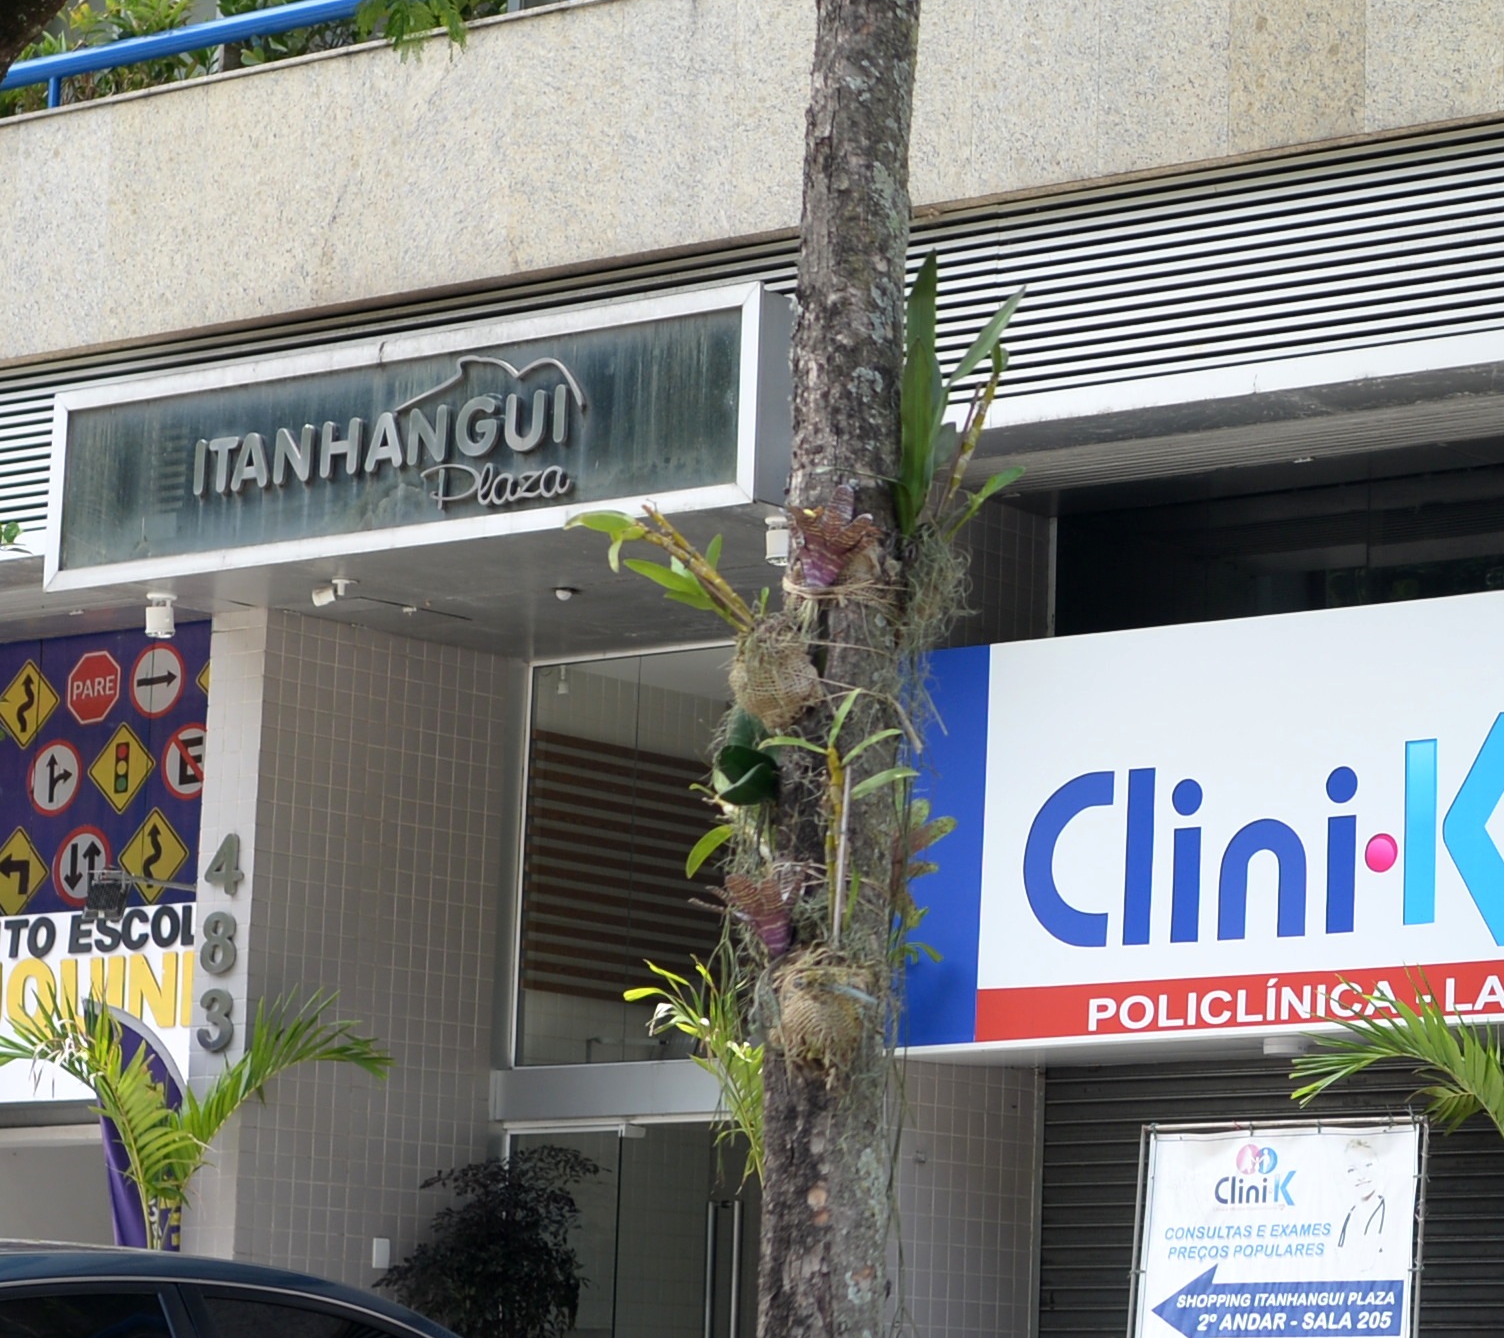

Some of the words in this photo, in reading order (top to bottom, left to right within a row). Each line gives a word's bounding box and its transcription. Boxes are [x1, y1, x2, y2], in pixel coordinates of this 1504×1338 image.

[194, 384, 569, 497] ITANHANGUI
[421, 462, 571, 511] Plaza
[72, 675, 115, 701] PARE
[1087, 975, 1398, 1033] POLICLÍNICA
[1164, 1224, 1252, 1240] CONSULTAS
[1256, 1224, 1267, 1238] E
[1269, 1222, 1332, 1237] EXAMES
[1167, 1244, 1230, 1263] PREÇOS
[1233, 1242, 1325, 1258] POPULARES
[1176, 1294, 1251, 1309] SHOPPING
[1253, 1292, 1345, 1307] ITANHANGUI
[1347, 1291, 1396, 1306] PLAZA
[1197, 1313, 1218, 1331] 2º
[1219, 1313, 1287, 1331] ANDAR
[1301, 1312, 1352, 1330] SALA
[1356, 1311, 1393, 1329] 205
